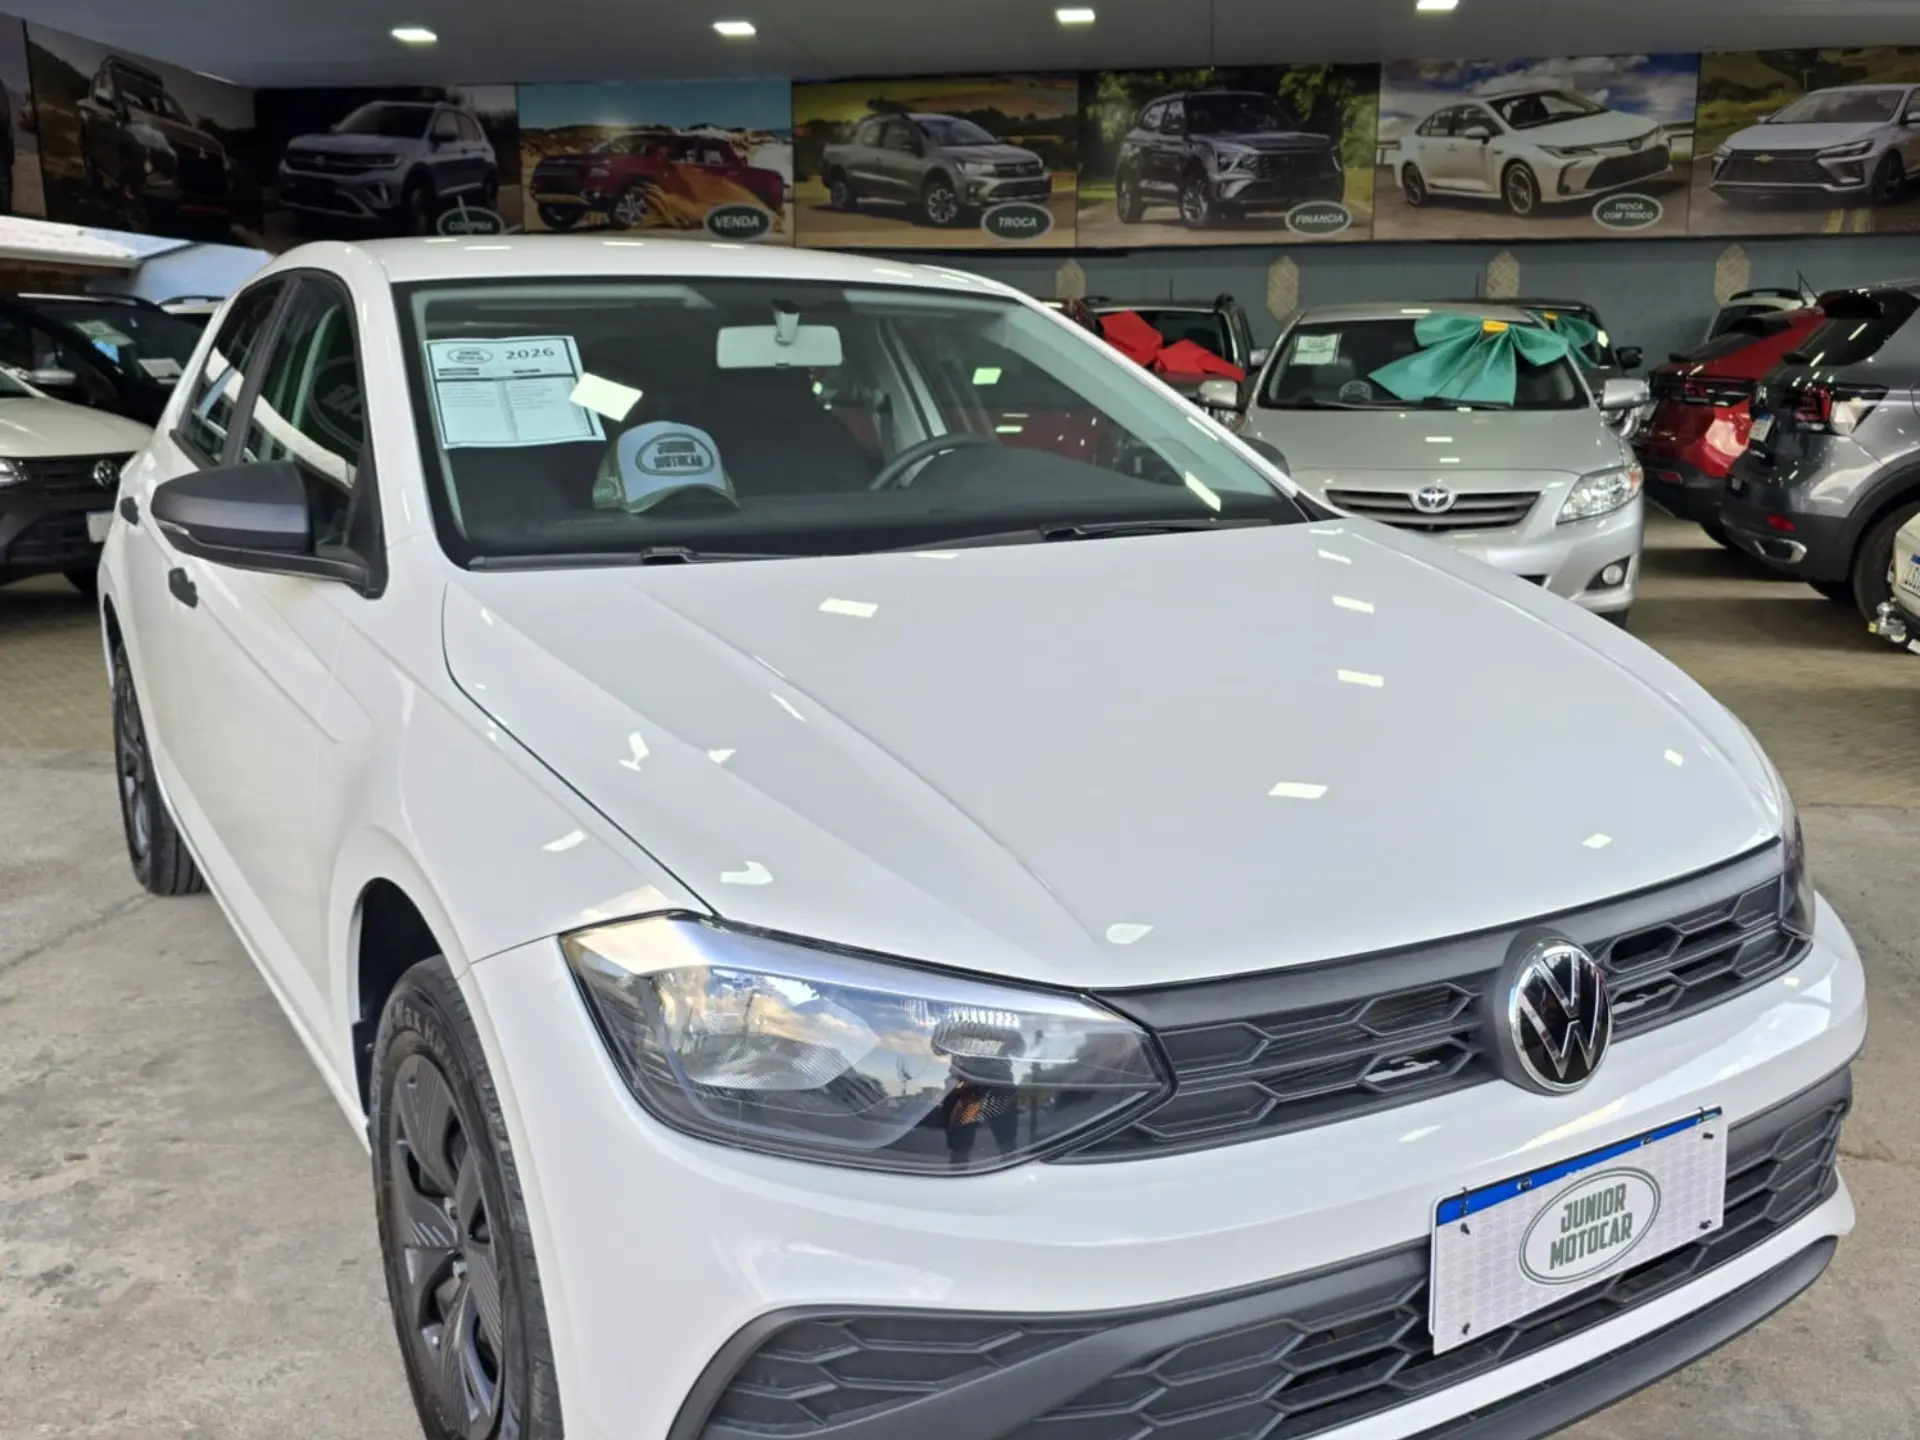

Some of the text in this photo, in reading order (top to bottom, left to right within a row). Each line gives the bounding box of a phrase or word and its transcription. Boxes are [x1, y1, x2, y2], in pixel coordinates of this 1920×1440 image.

[714, 214, 759, 229] VENDA
[998, 216, 1037, 229] TROCA
[1295, 212, 1345, 226] FINANCIA
[504, 347, 555, 361] 2026
[1560, 1183, 1627, 1234] JUNIOR
[1549, 1212, 1633, 1270] MOTOCAR
